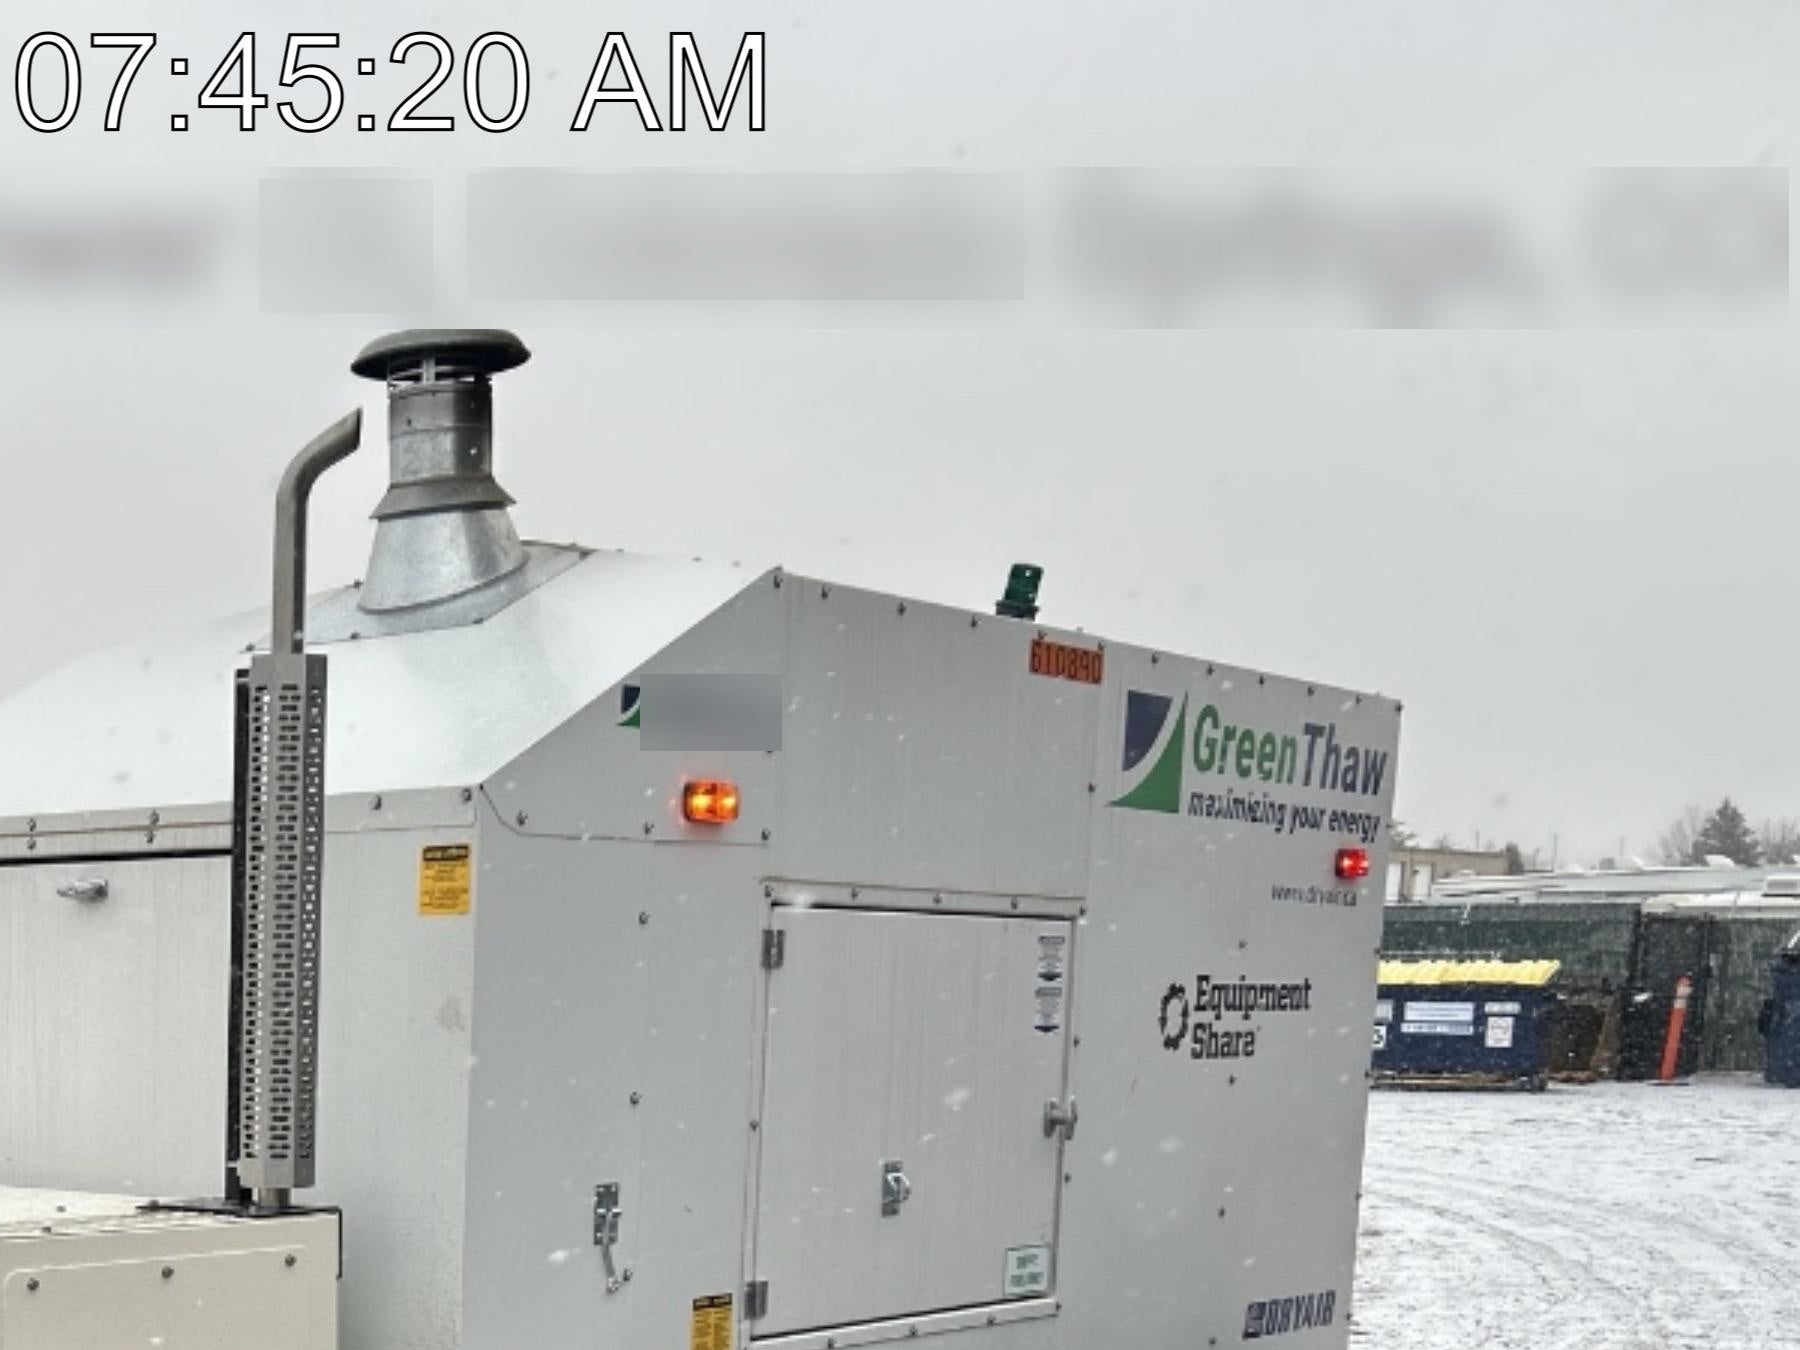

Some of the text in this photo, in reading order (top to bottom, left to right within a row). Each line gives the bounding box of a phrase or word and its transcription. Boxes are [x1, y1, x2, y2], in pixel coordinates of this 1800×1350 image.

[1030, 641, 1102, 684] 610890
[1188, 788, 1381, 844] maximizing your energy
[1193, 974, 1312, 1020] Equipment
[1191, 1022, 1256, 1060] Share
